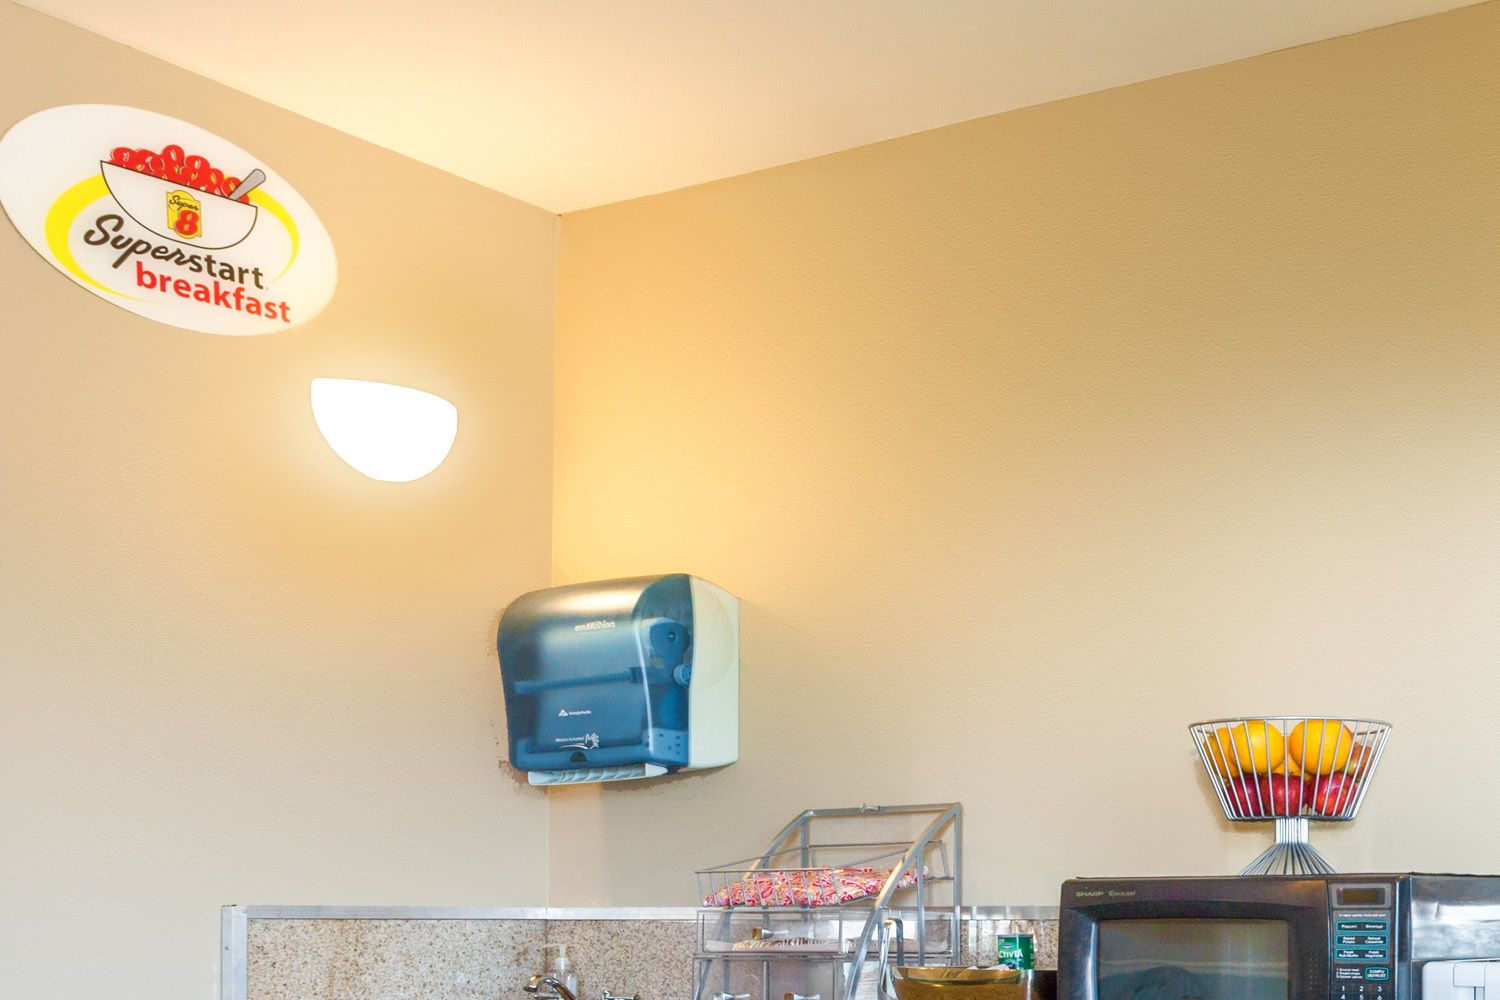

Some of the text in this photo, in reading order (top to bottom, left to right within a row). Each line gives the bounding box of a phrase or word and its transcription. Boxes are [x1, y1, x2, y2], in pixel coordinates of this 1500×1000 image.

[83, 213, 264, 290] Superstart
[174, 209, 200, 236] 8
[135, 261, 290, 323] breakfast
